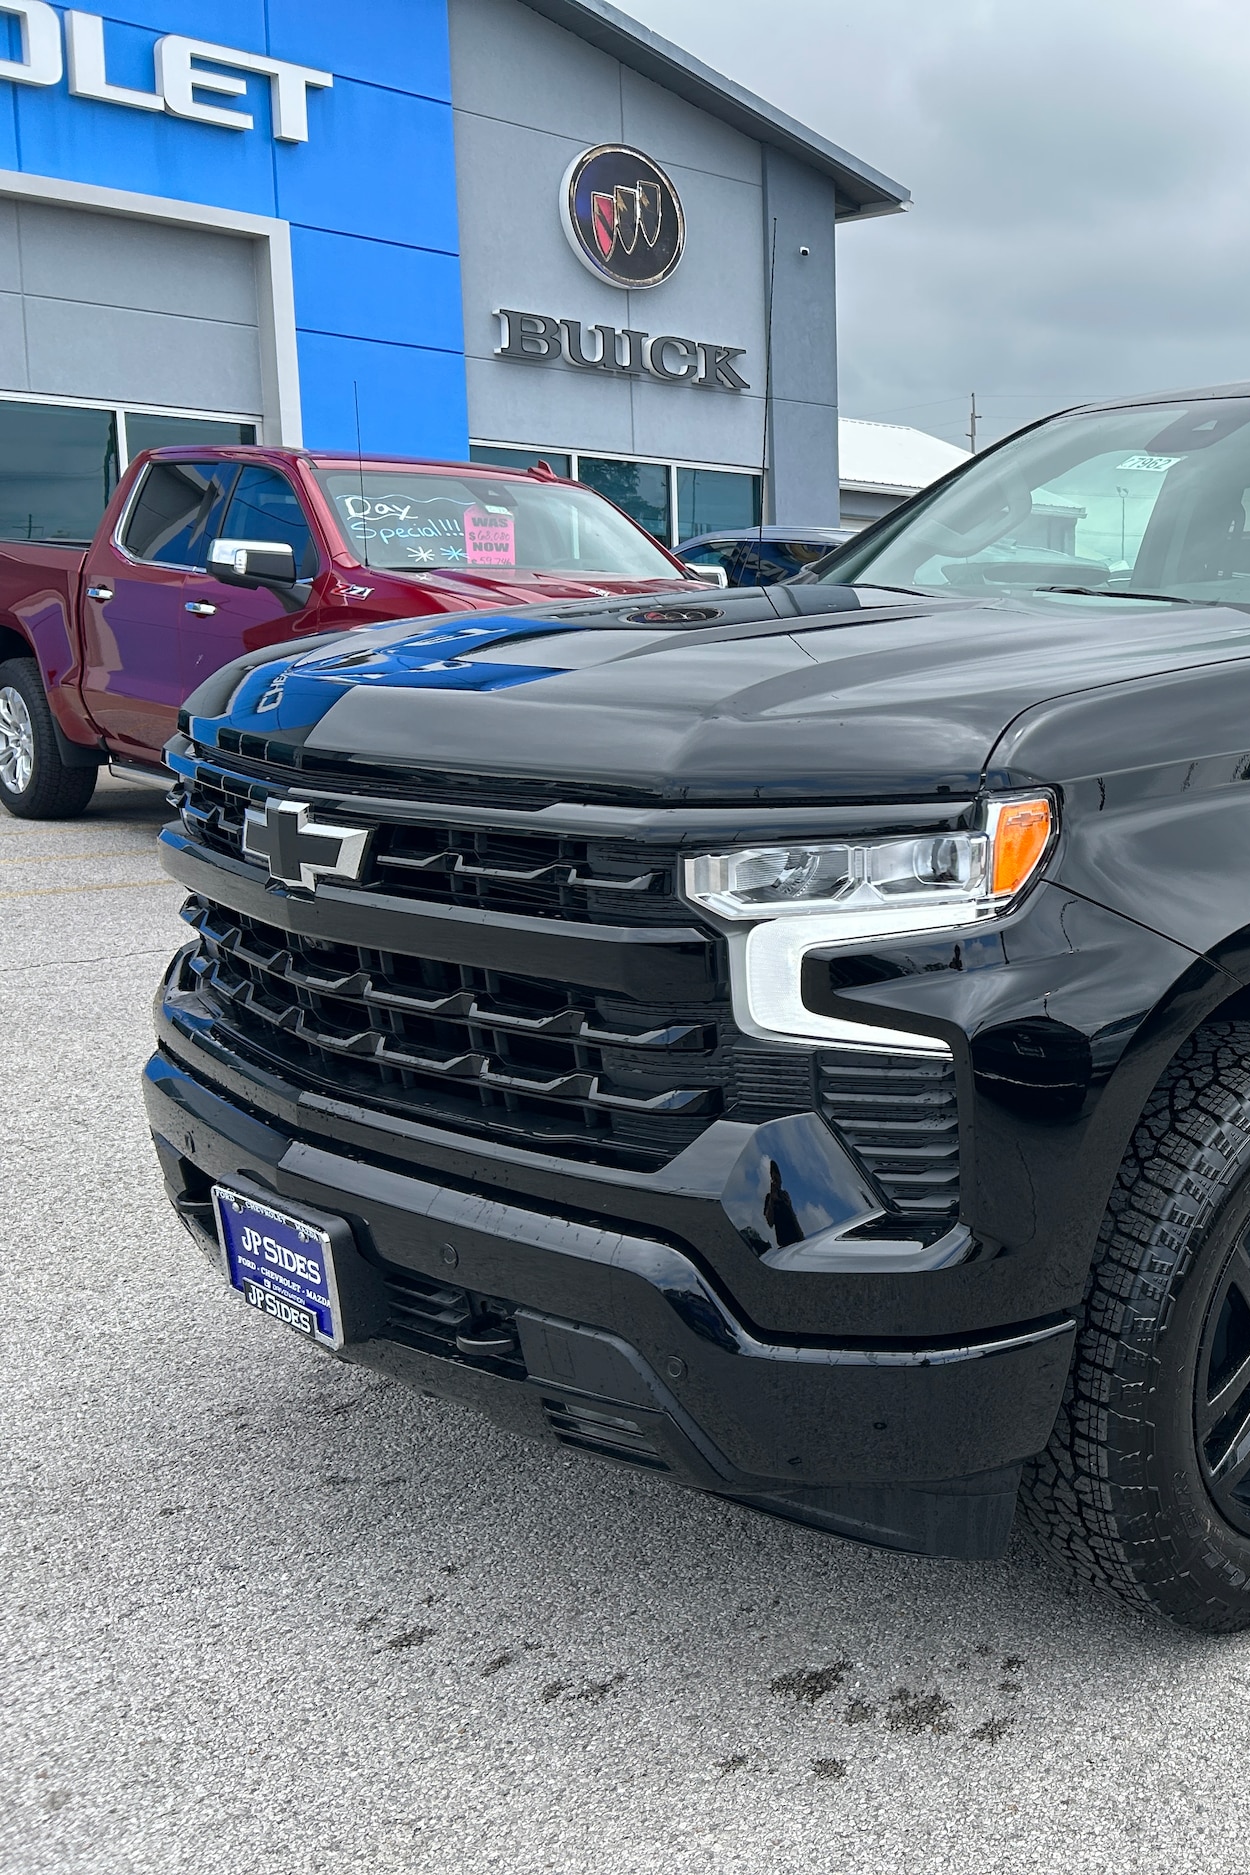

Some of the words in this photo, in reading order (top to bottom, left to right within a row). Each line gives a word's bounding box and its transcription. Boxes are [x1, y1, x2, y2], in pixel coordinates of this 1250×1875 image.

[492, 308, 751, 390] BUICK
[344, 496, 411, 521] Day
[471, 517, 509, 528] WAS
[473, 542, 510, 552] NOW
[215, 1189, 236, 1202] FORD
[244, 1200, 287, 1226] CHEVROLET
[242, 1226, 262, 1256] JP
[262, 1236, 322, 1285] SIDES
[237, 1255, 257, 1270] FORD
[260, 1266, 302, 1293] CHEVROLET
[305, 1288, 331, 1308] MAZDA
[248, 1284, 265, 1309] JP
[265, 1293, 311, 1334] SIDES
